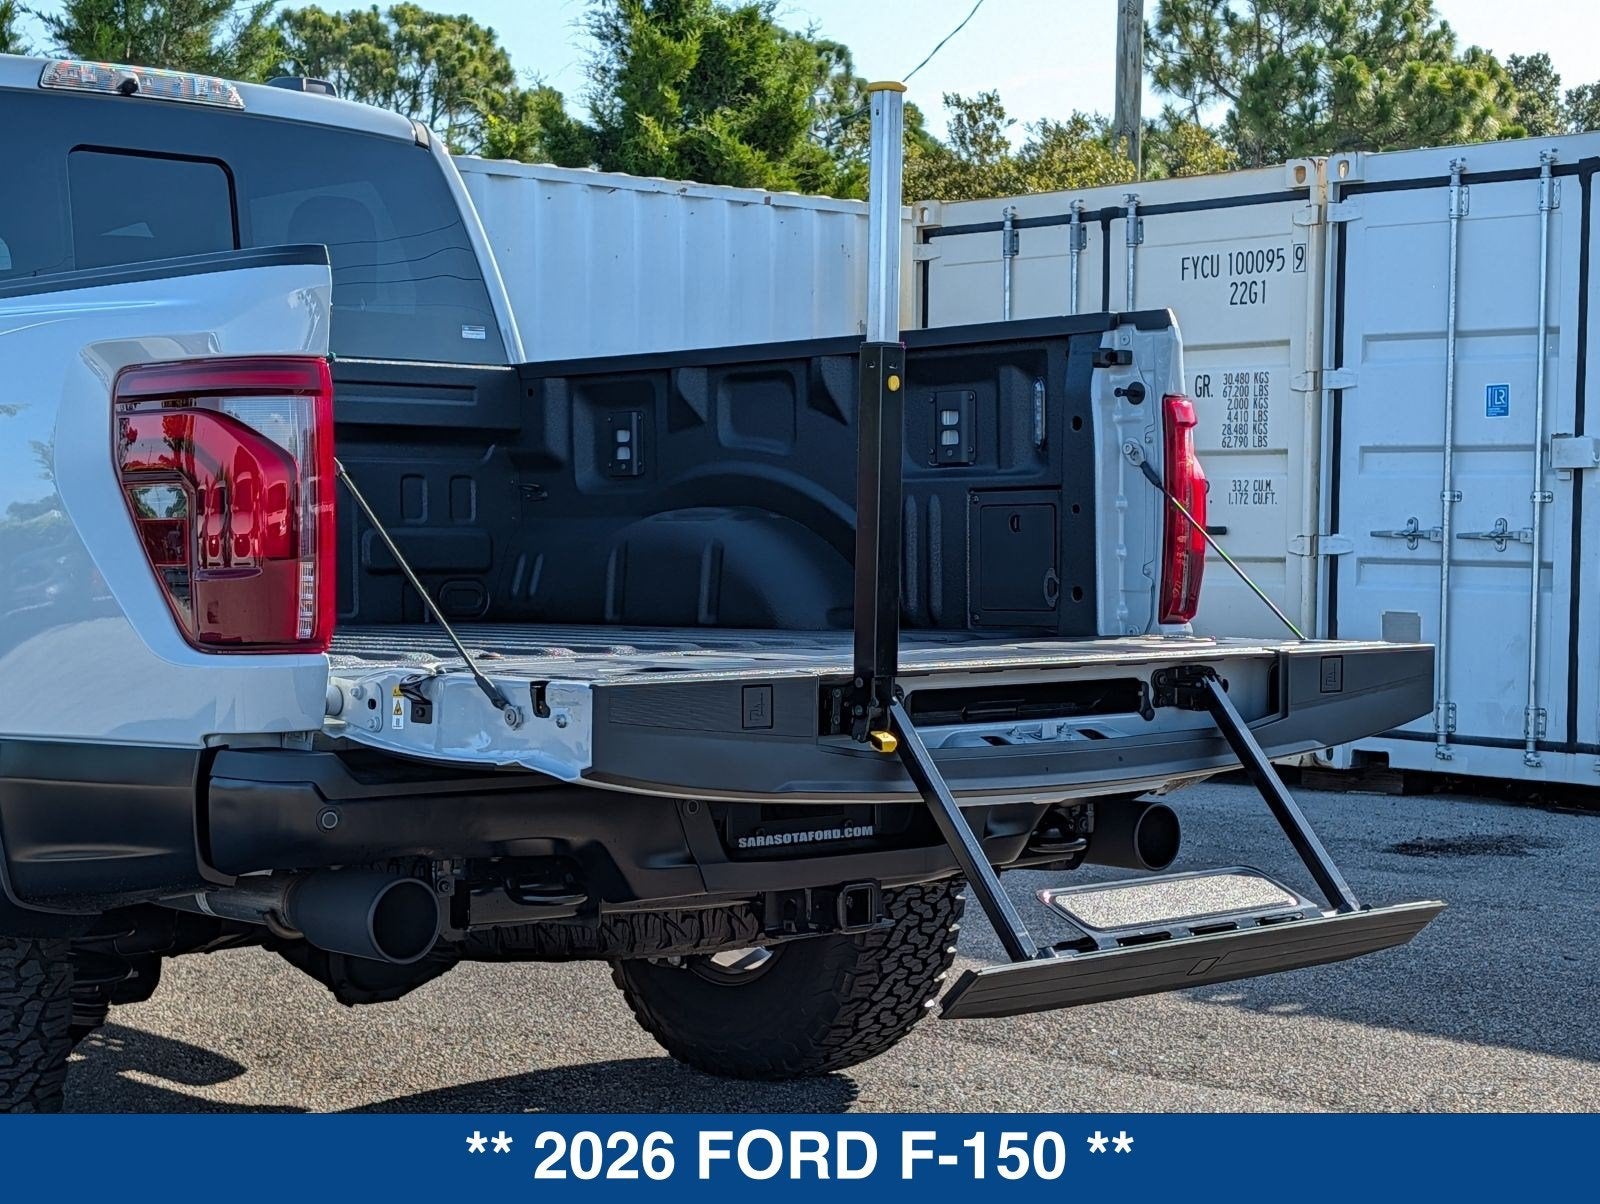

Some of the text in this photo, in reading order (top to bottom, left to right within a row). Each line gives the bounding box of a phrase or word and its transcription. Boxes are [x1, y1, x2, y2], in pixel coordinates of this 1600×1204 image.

[1181, 245, 1306, 281] FYCU 100095 9
[1229, 280, 1266, 305] 22G1
[1195, 372, 1269, 398] GR. 30.480 KGS
[1222, 385, 1269, 398] 67.200 LBS
[1227, 398, 1269, 410] 2.000 KGS
[1227, 410, 1268, 423] 4.410 LBS
[1222, 423, 1268, 436] 28.480 KGS
[1221, 435, 1268, 448] 62.790 LBS
[738, 825, 873, 848] SARASOTAFORD.COM
